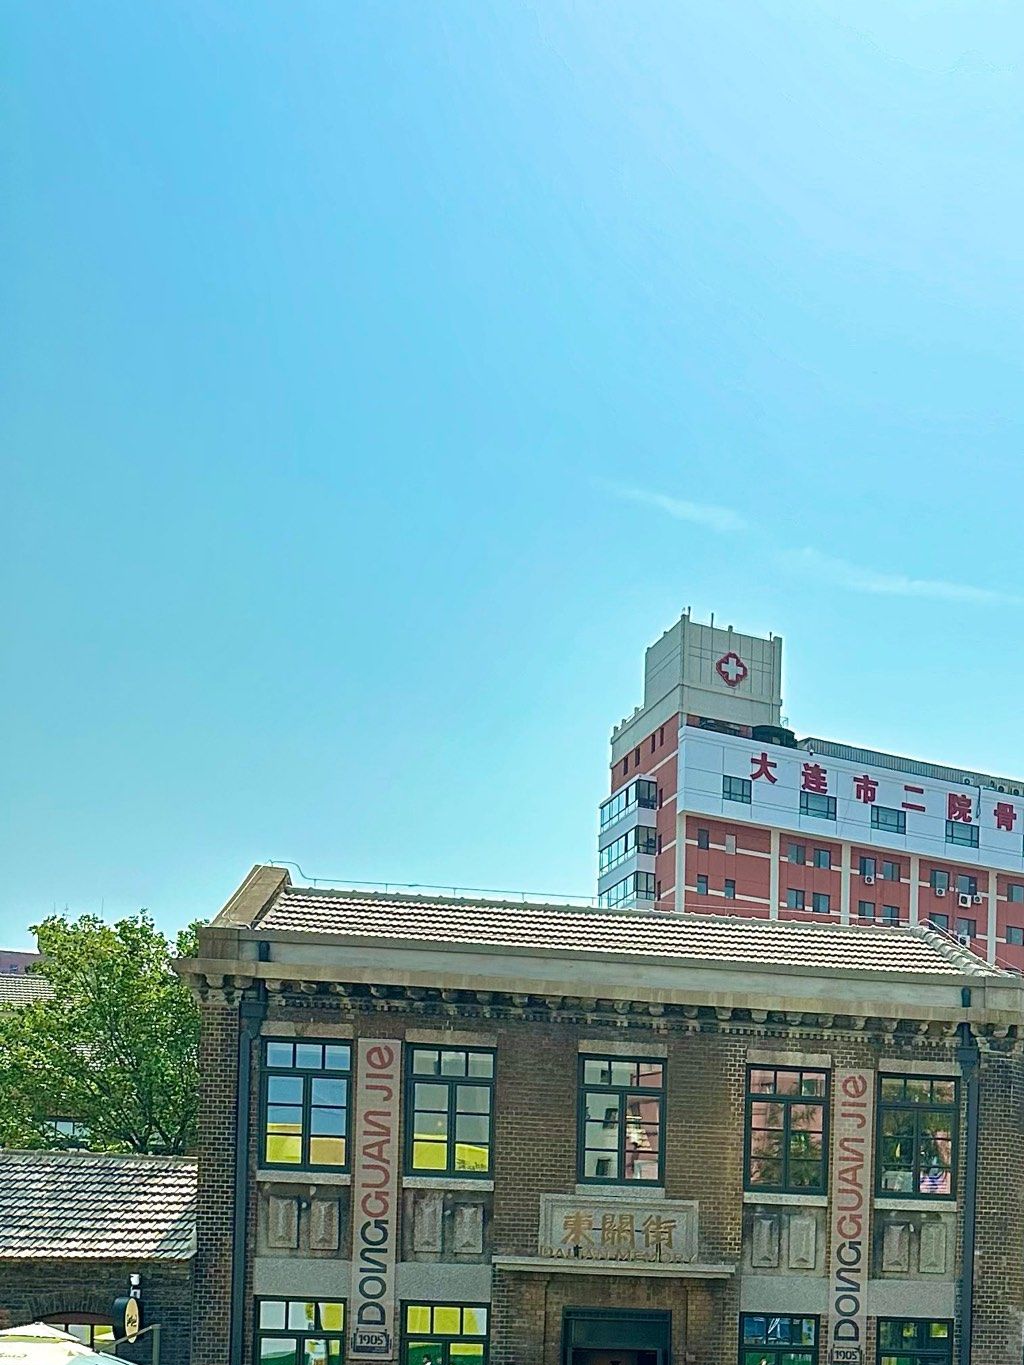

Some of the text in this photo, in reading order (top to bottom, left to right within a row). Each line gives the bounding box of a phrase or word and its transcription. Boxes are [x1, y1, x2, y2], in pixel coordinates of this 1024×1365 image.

[561, 1209, 678, 1250] 東關街
[358, 1334, 384, 1345] 1905
[834, 1350, 858, 1360] 1905
